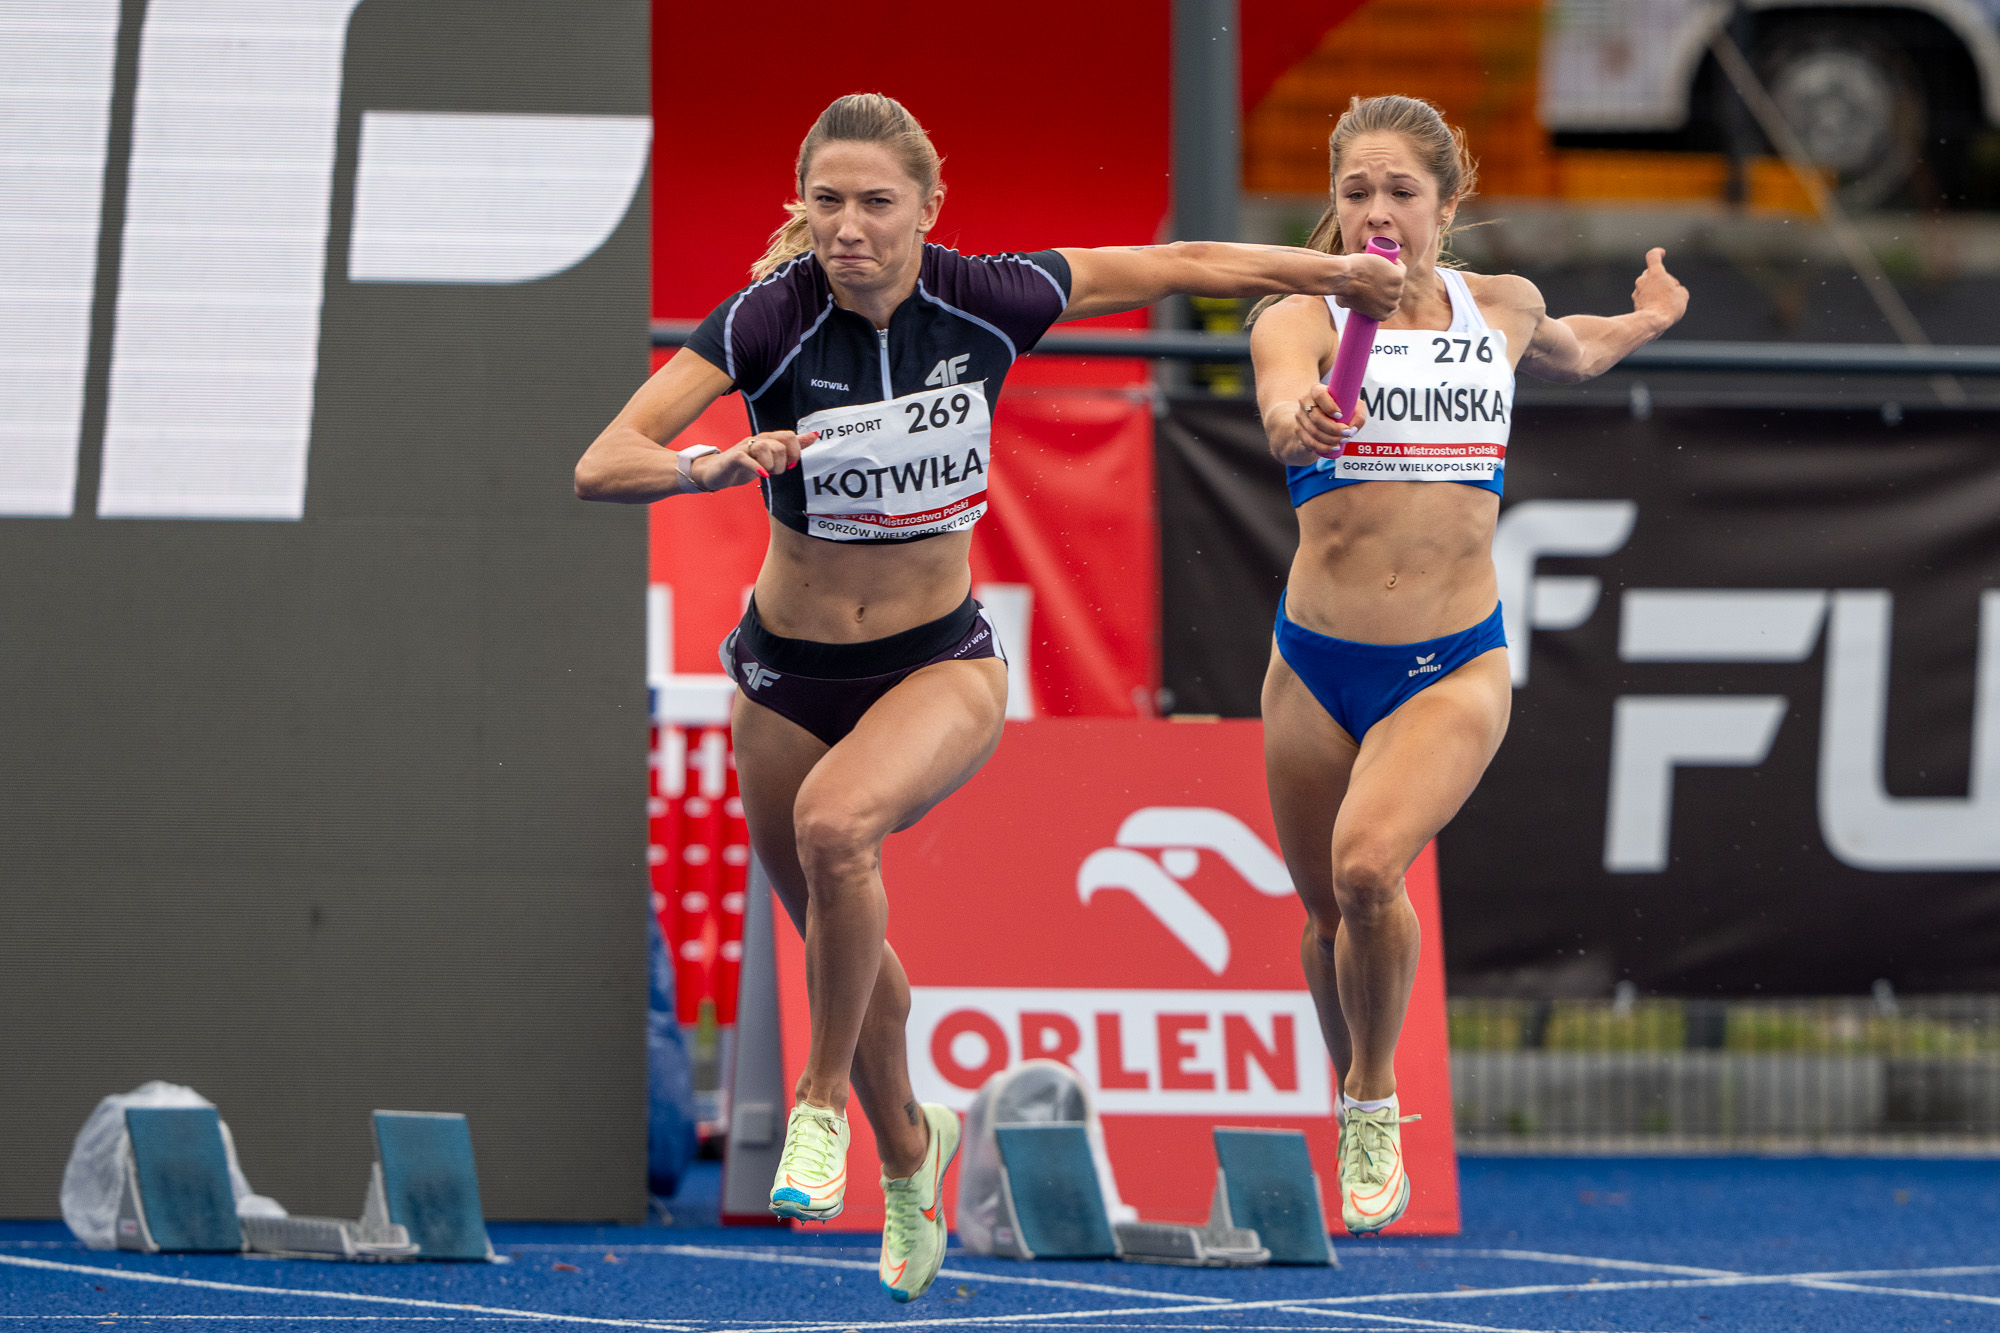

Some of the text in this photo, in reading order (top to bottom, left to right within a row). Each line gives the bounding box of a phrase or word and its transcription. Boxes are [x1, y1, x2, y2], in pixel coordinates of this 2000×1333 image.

[1432, 336, 1493, 363] 276
[925, 353, 971, 387] 4F
[811, 378, 849, 392] KOTWIŁA
[905, 394, 970, 433] 269
[818, 419, 882, 440] VP SPORT
[1357, 445, 1498, 456] 99. PZLA Mistrzostwa Polski
[813, 448, 984, 498] KOTWIŁA
[1343, 460, 1396, 472] GORZÓW
[1399, 462, 1484, 472] WIELKOPOLSKI
[818, 520, 871, 538] GORZÓW
[958, 509, 982, 526] 2023
[879, 511, 942, 526] Mistrzostwa
[943, 499, 969, 517] Polski
[741, 661, 782, 691] 4F
[929, 1007, 1300, 1092] ORLEN
